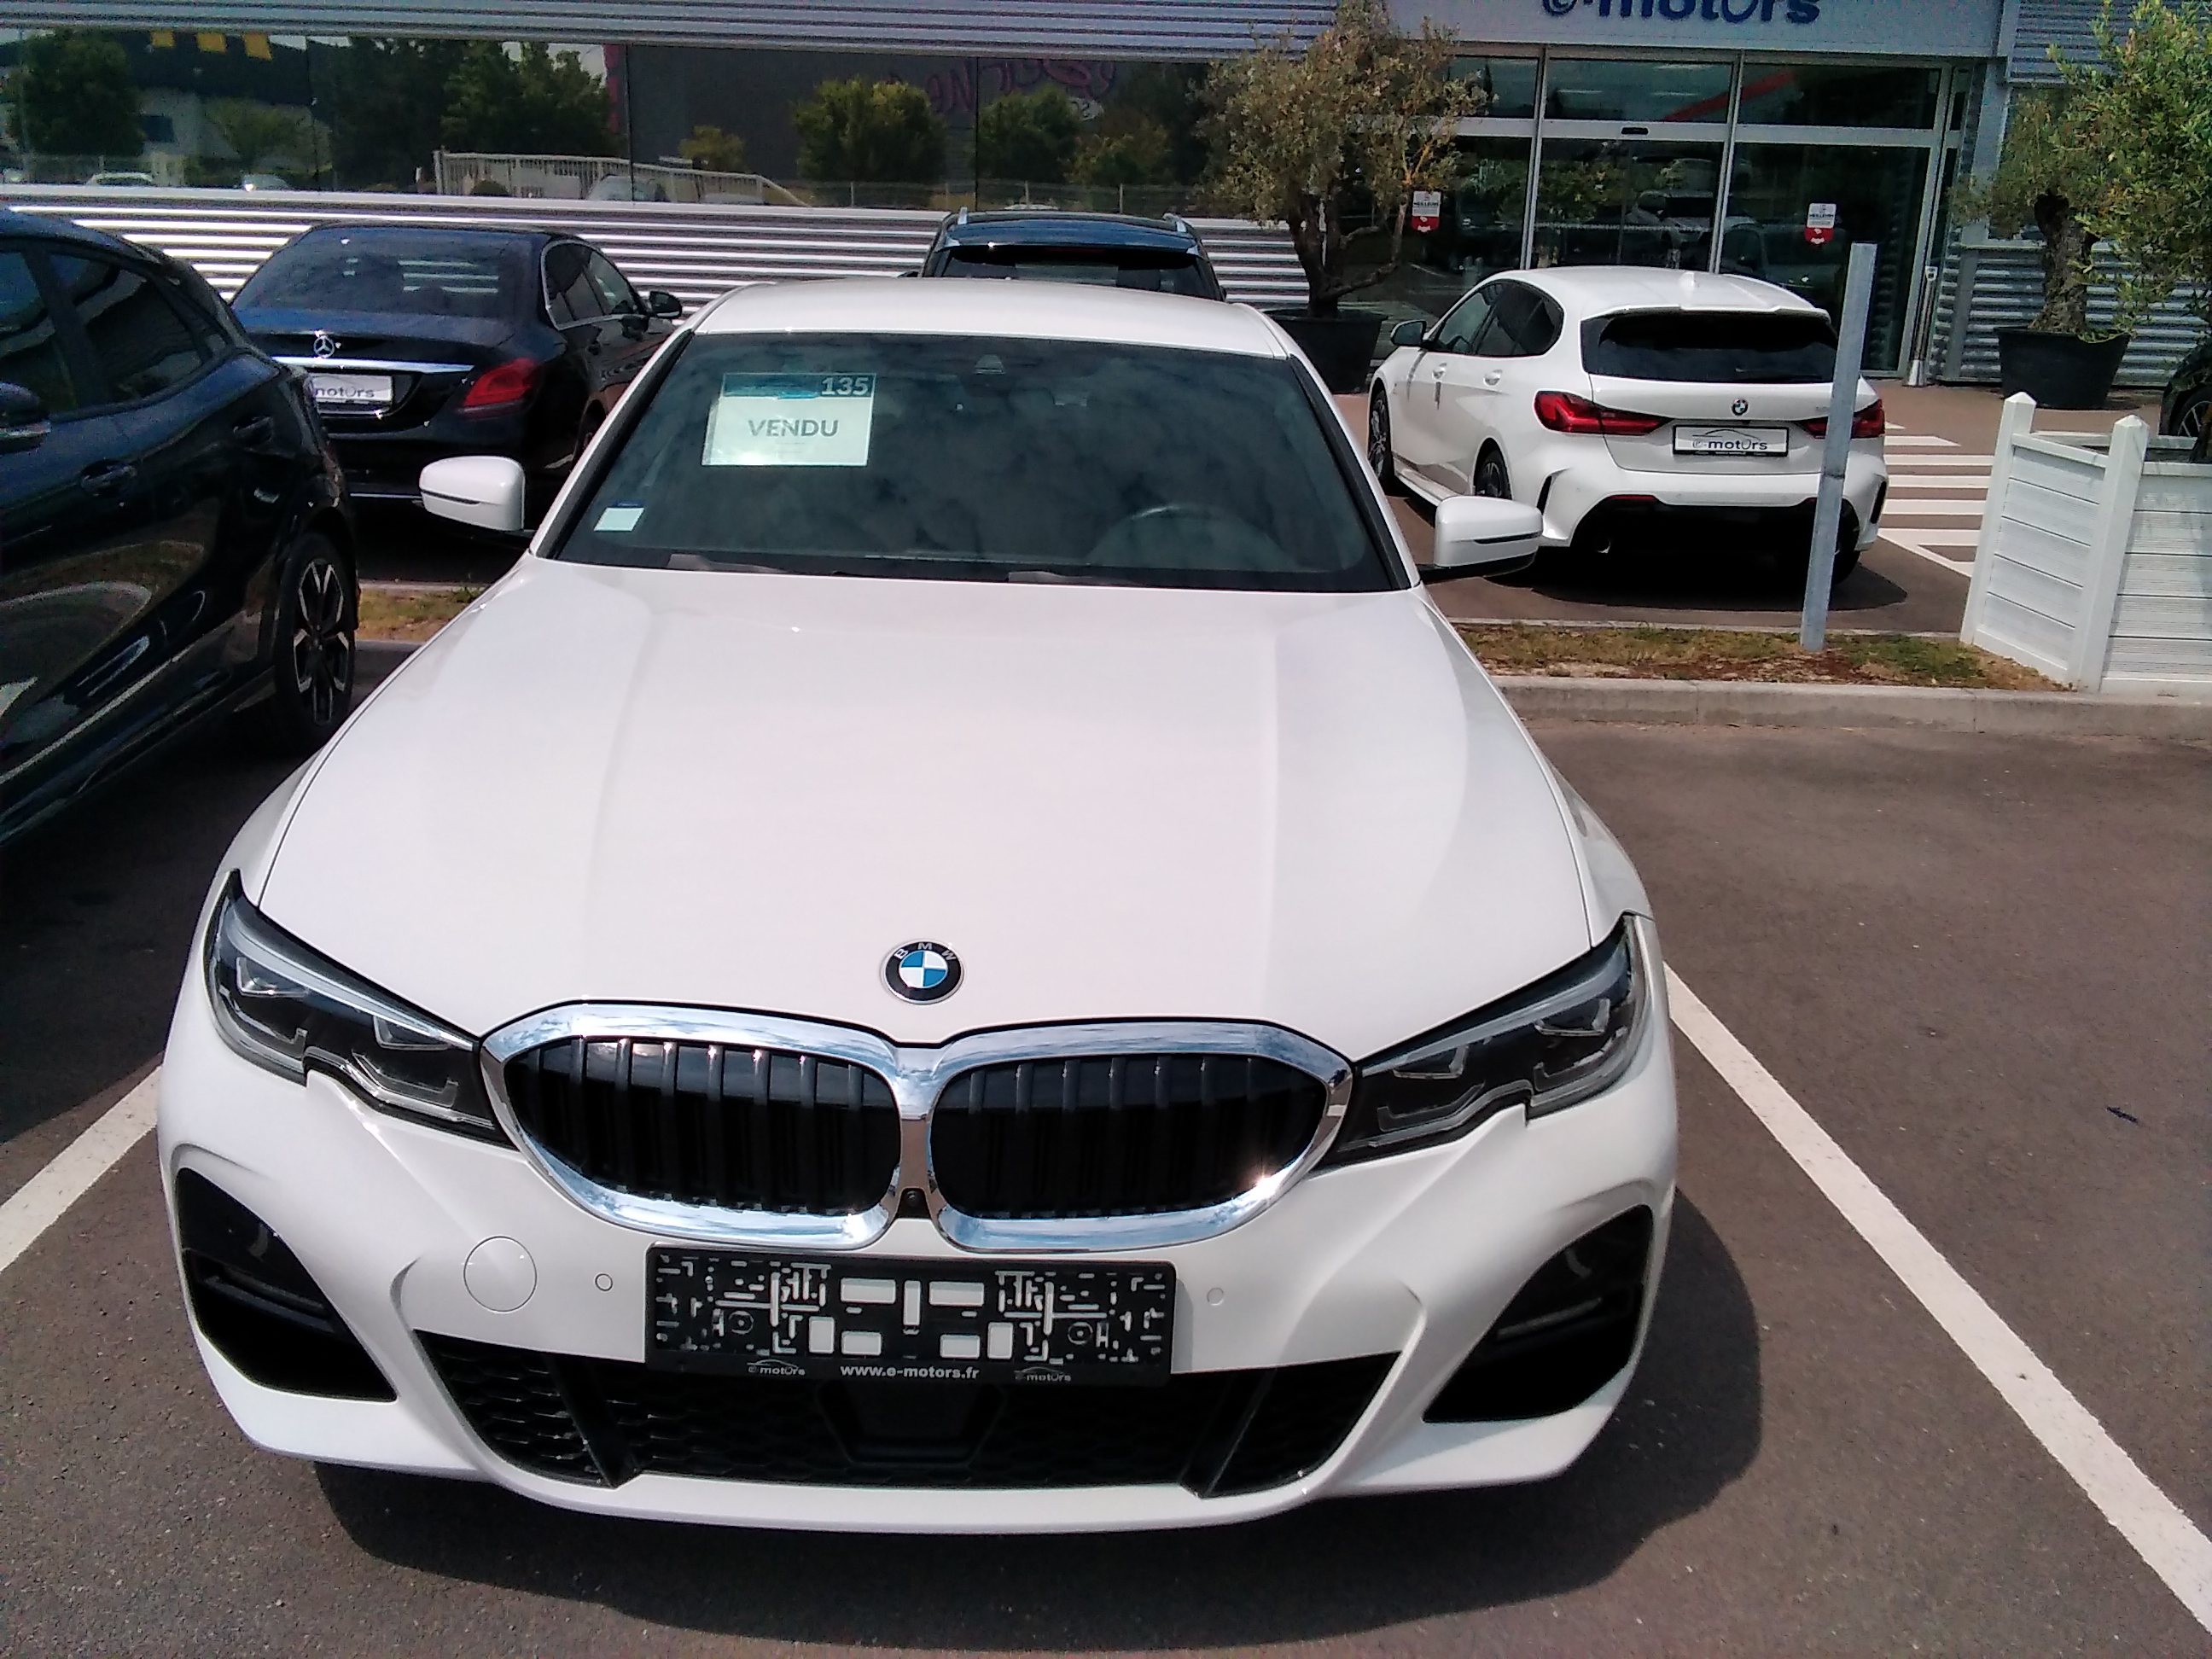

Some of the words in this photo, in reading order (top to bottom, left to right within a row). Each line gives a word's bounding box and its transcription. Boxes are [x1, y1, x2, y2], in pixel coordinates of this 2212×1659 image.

[821, 376, 869, 396] 135
[748, 418, 839, 437] VENDU
[894, 942, 957, 961] BMW
[840, 1365, 980, 1379] www.e-motors.fr
